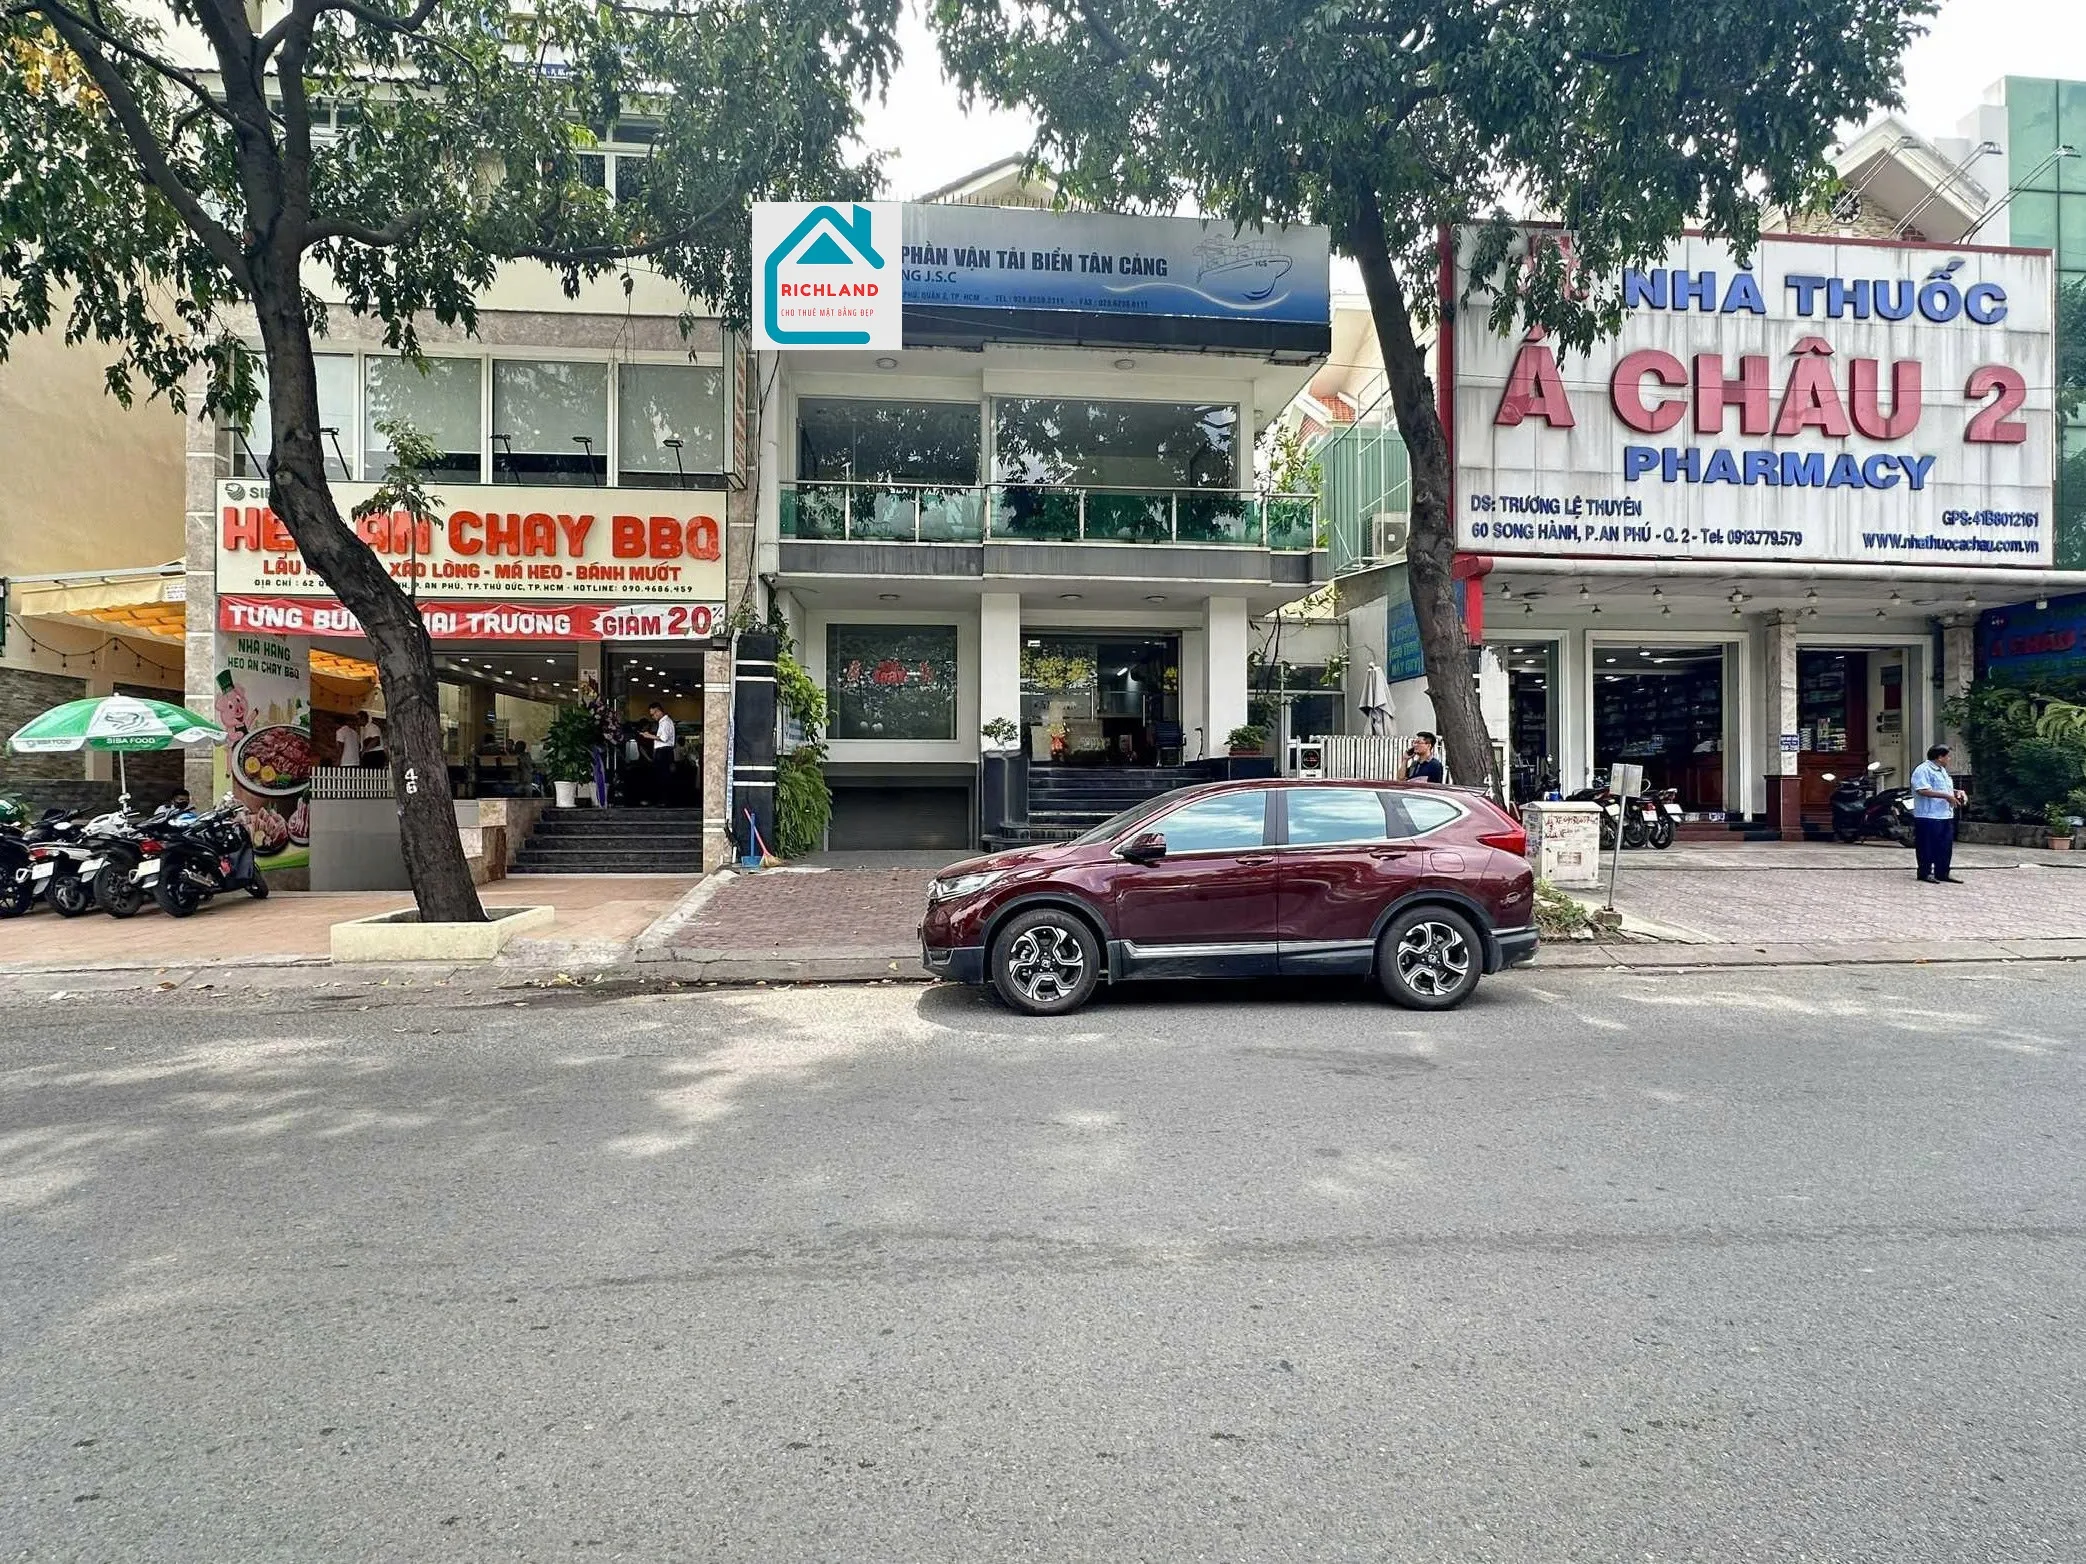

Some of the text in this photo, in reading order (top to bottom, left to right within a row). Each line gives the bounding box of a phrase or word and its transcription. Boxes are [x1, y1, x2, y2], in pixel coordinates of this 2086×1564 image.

[954, 246, 990, 271] VẬN
[996, 246, 1026, 269] TẢI
[1032, 246, 1073, 272] BIỂN
[1078, 251, 1113, 274] TÂN
[1118, 252, 1168, 277] CẢNG
[924, 270, 956, 283] J.S.C
[1624, 260, 2009, 326] NHÀ THUỐC
[1494, 323, 2027, 444] Á CHÂU 2
[1624, 445, 1937, 491] PHARMACY
[1470, 494, 1496, 512] DS:
[1565, 495, 1583, 519] LỆ
[1586, 496, 1642, 517] THUYÊN
[223, 507, 298, 552] HE
[449, 511, 595, 558] CHAY
[612, 515, 721, 562] BBQ
[1472, 522, 1489, 538] 60
[1492, 522, 1534, 539] SONG
[1538, 519, 1581, 543] HÀNH,
[1623, 521, 1651, 543] PHÚ
[1663, 527, 1679, 543] Q.
[1681, 528, 1690, 544] 2
[389, 559, 427, 578] XÁO
[432, 559, 480, 578] LÒNG
[495, 560, 523, 579] MÁ
[528, 564, 563, 580] HEO
[576, 561, 625, 581] BÁNH
[629, 561, 682, 581] MƯỚT
[466, 611, 571, 635] TRƯƠNG
[228, 656, 245, 669] HEO
[262, 661, 282, 676] CHAY
